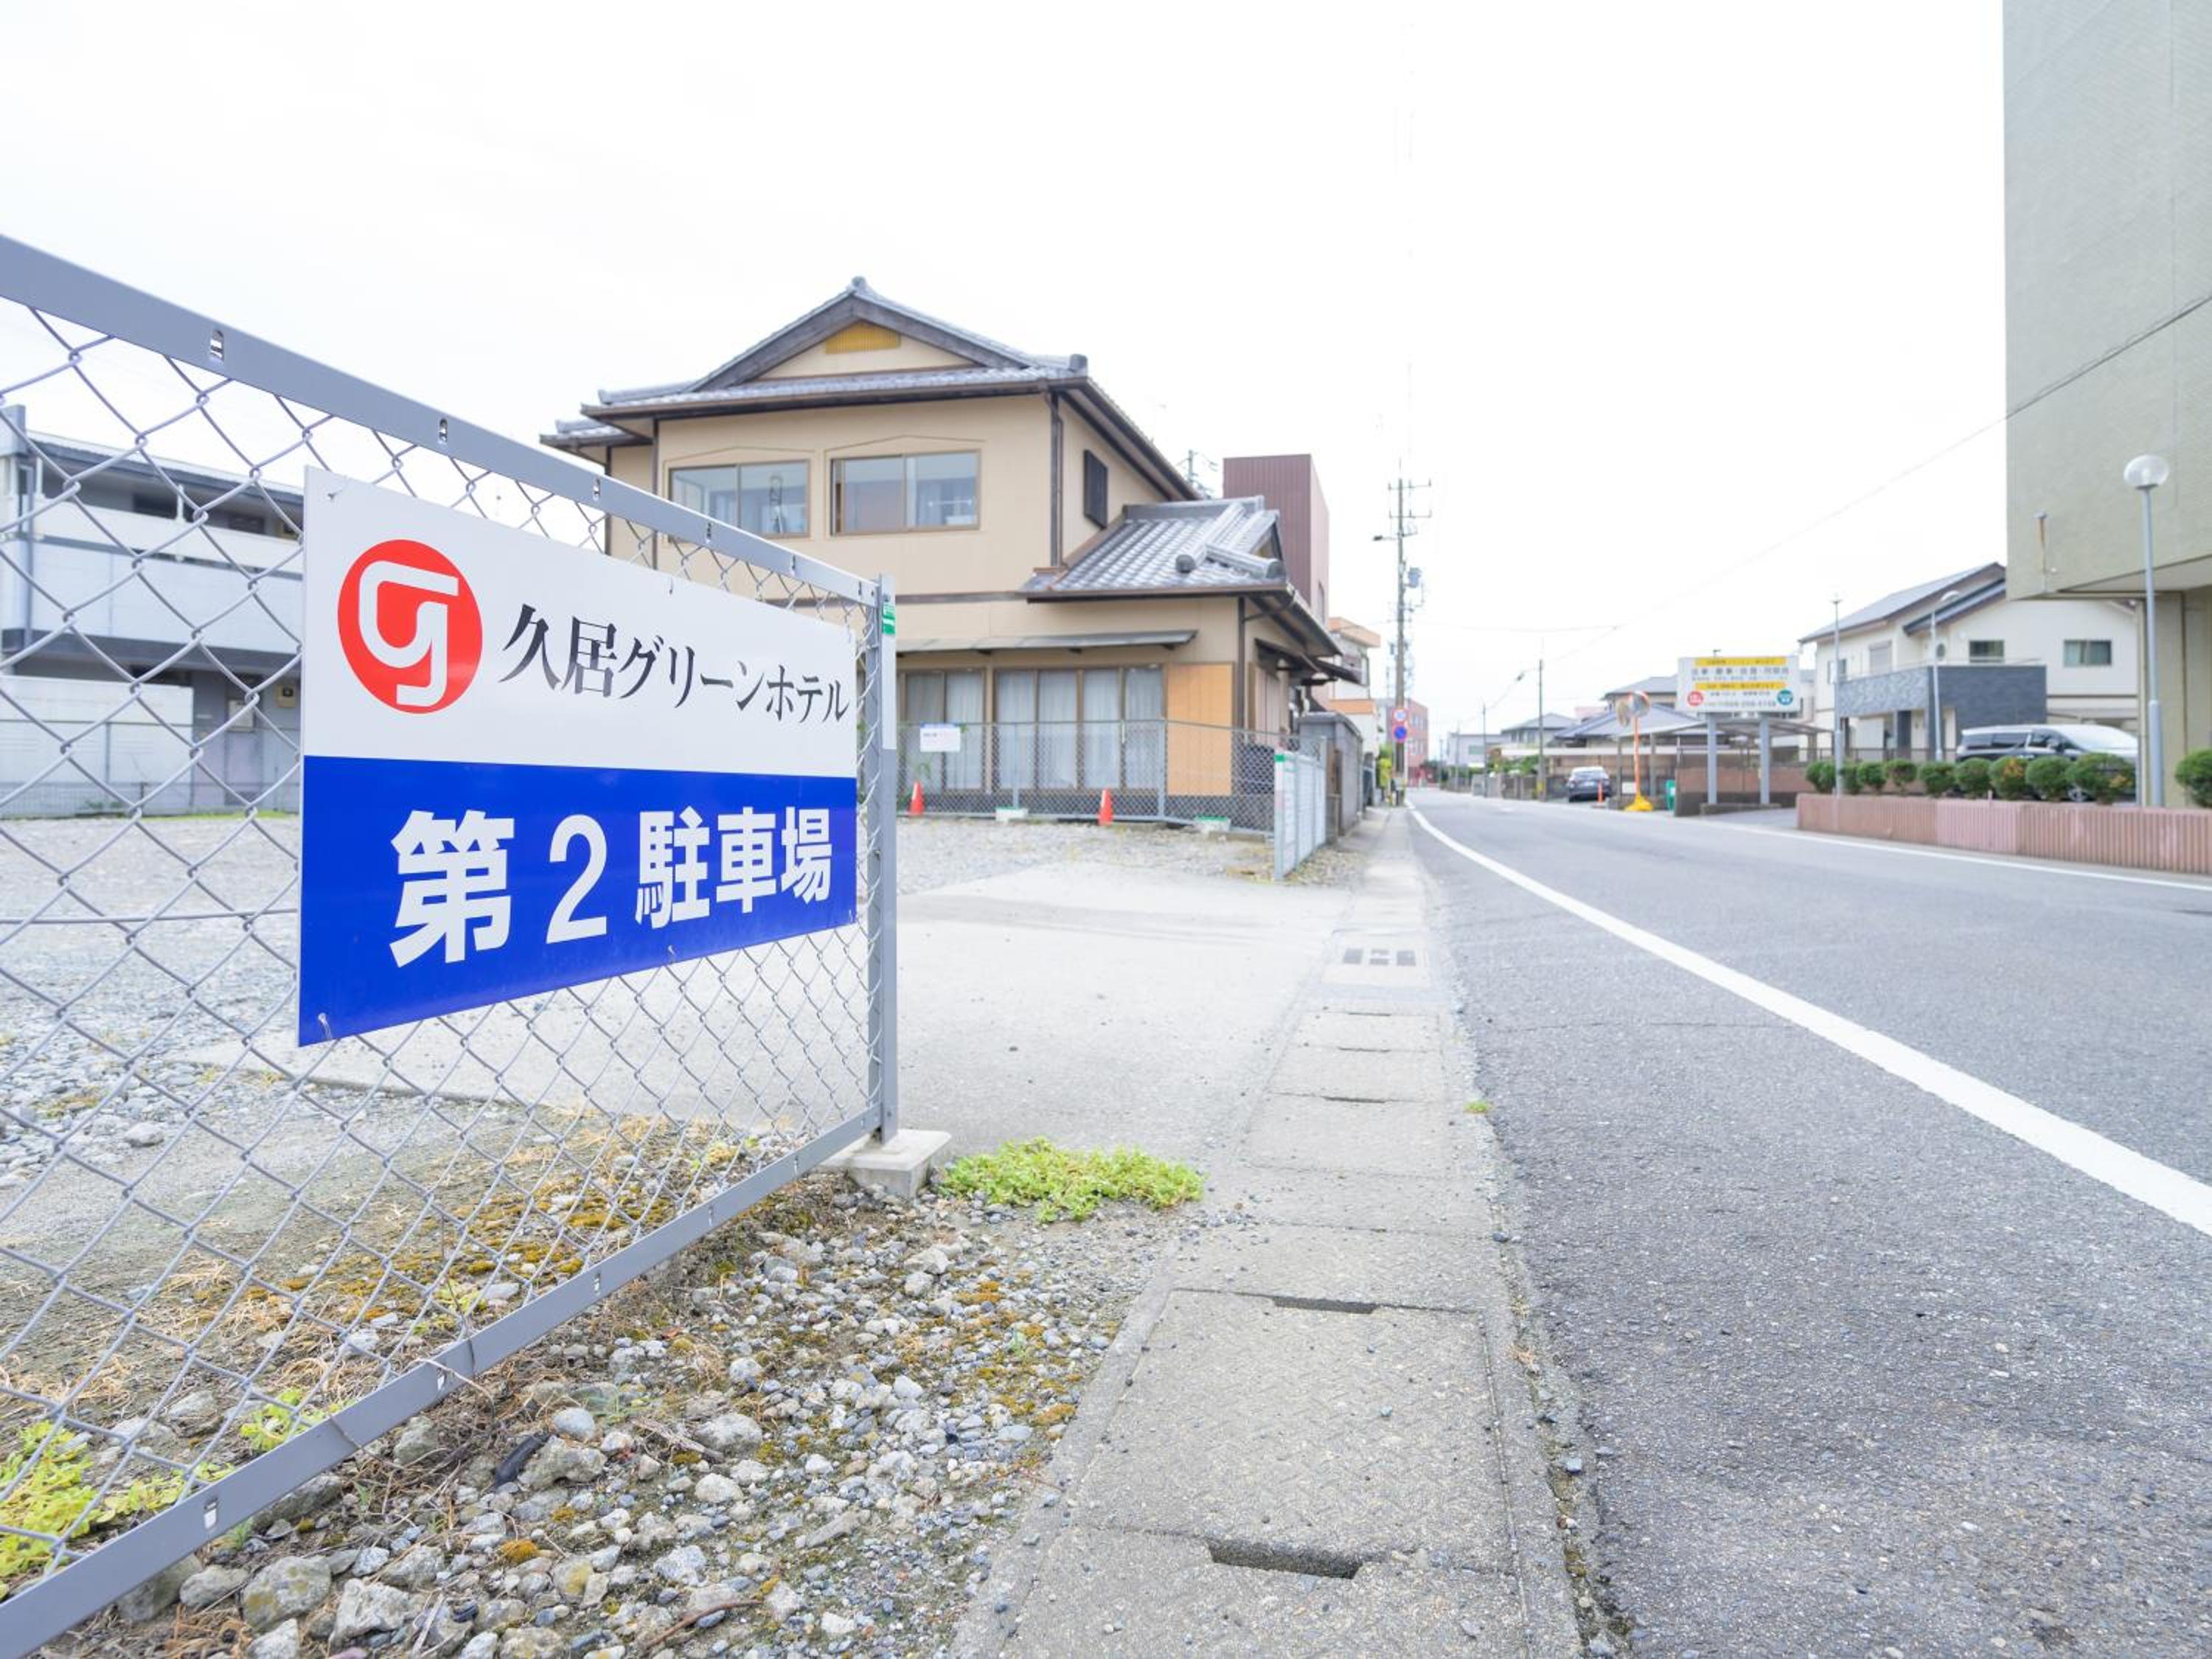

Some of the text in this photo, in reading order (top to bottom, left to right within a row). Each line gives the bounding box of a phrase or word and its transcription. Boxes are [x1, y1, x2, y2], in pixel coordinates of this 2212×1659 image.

[498, 603, 849, 724] 久居グリーンホテル
